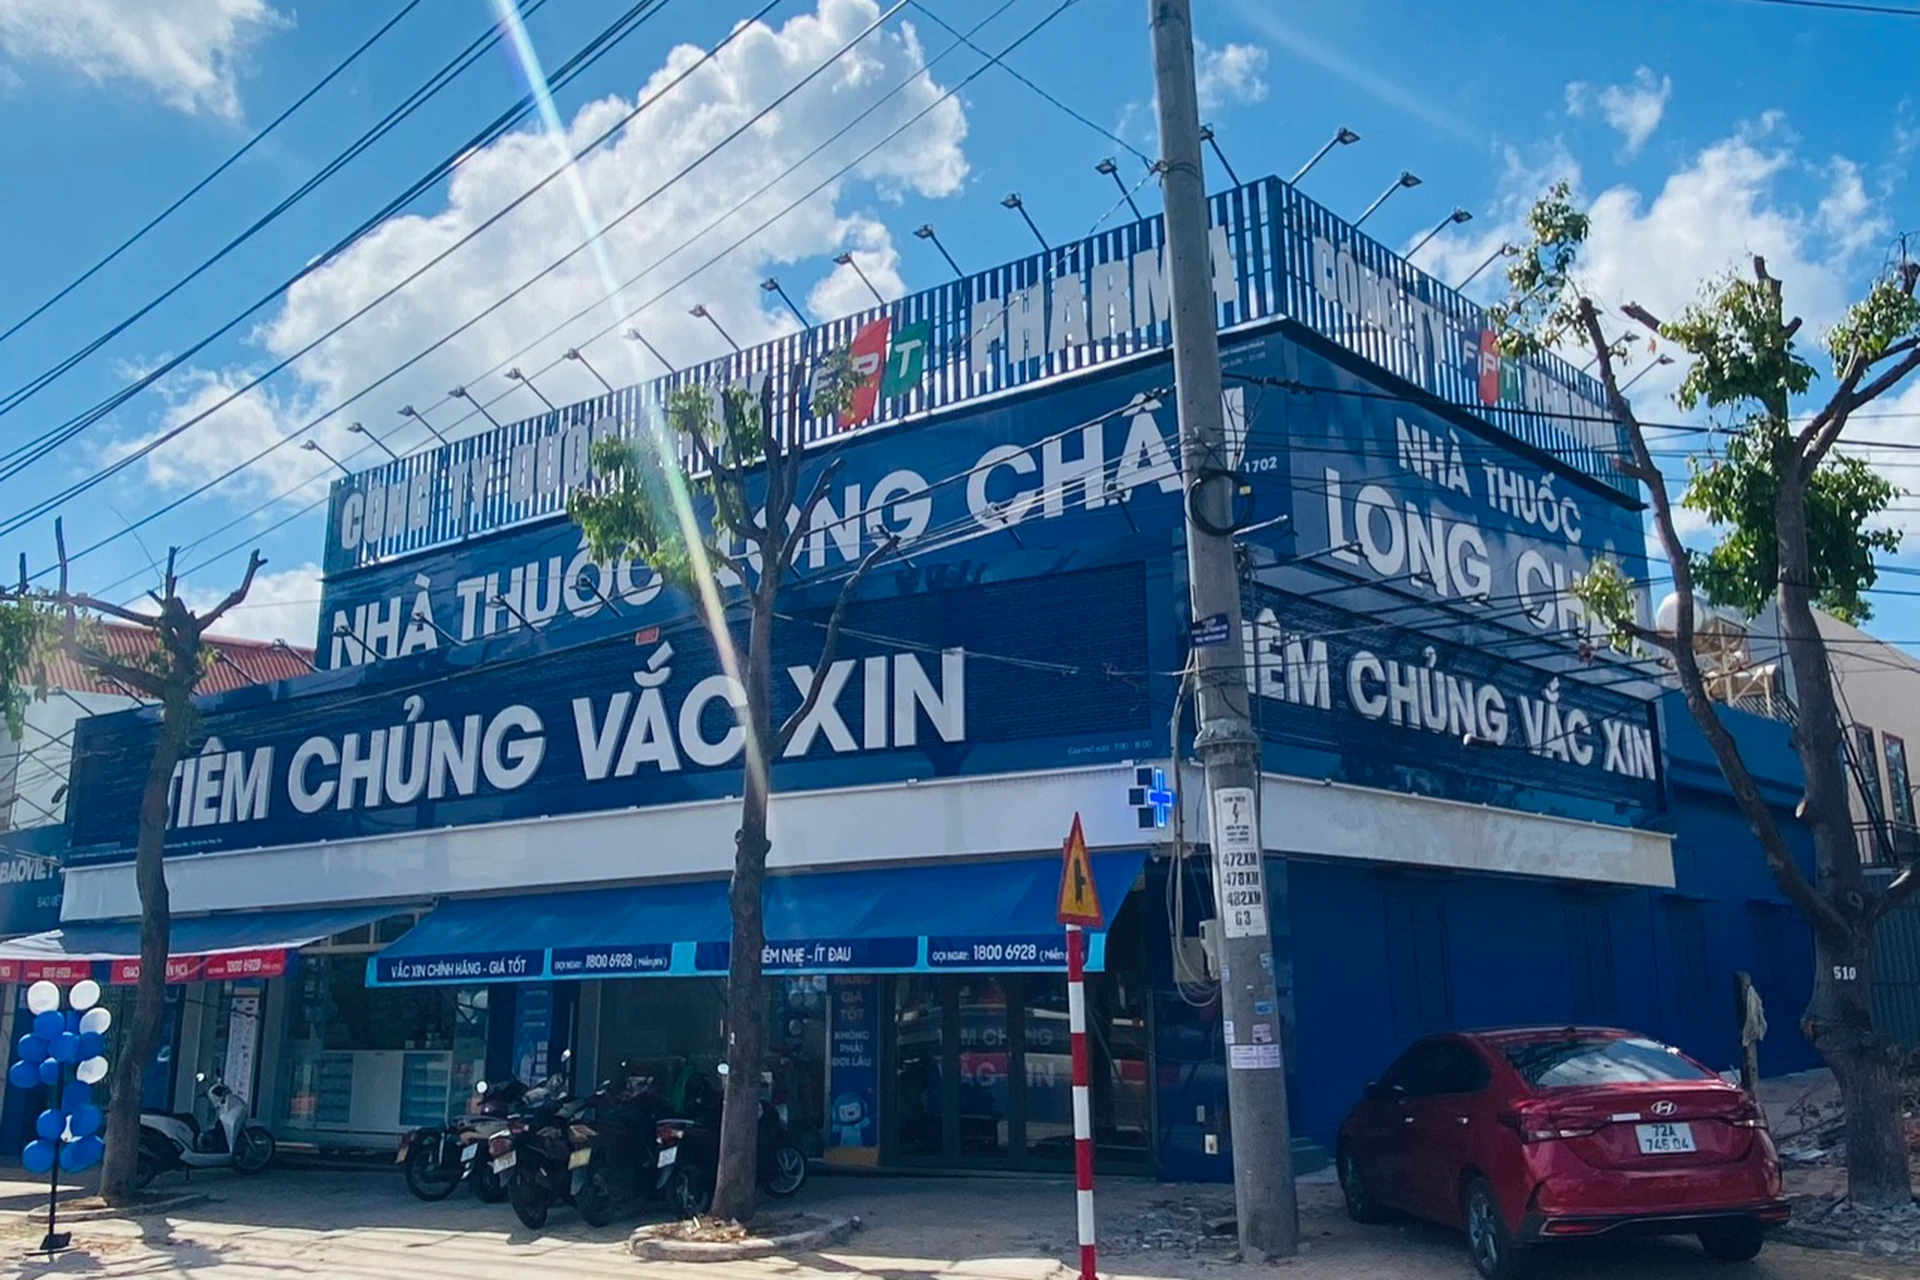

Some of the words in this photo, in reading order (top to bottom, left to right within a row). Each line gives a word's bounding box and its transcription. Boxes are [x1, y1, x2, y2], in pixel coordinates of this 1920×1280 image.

[1313, 234, 1400, 339] CÔNG
[1402, 293, 1446, 366] TY
[1244, 456, 1278, 473] 1702
[1396, 416, 1472, 498] NHÀ
[1481, 471, 1582, 544] THUỐC
[341, 472, 432, 550] CÔNG
[450, 454, 493, 519] TY
[1324, 466, 1492, 607] LONG
[330, 573, 439, 671] NHÀ
[288, 695, 547, 815] CHỦNG
[572, 640, 748, 781] VẮC
[782, 646, 966, 758] XIN
[1347, 646, 1508, 746] CHỦNG
[1518, 676, 1594, 767] VẮC
[1603, 718, 1657, 781] XIN
[411, 964, 426, 978] XIN
[489, 957, 506, 974] GIÁ
[507, 954, 527, 974] TỐT
[609, 953, 633, 968] 6928
[815, 943, 826, 962] ÍT
[828, 946, 851, 962] ĐAU
[974, 944, 1002, 961] 1800
[1005, 944, 1036, 960] 6928
[1834, 966, 1856, 980] 510
[1651, 1124, 1677, 1137] 72A
